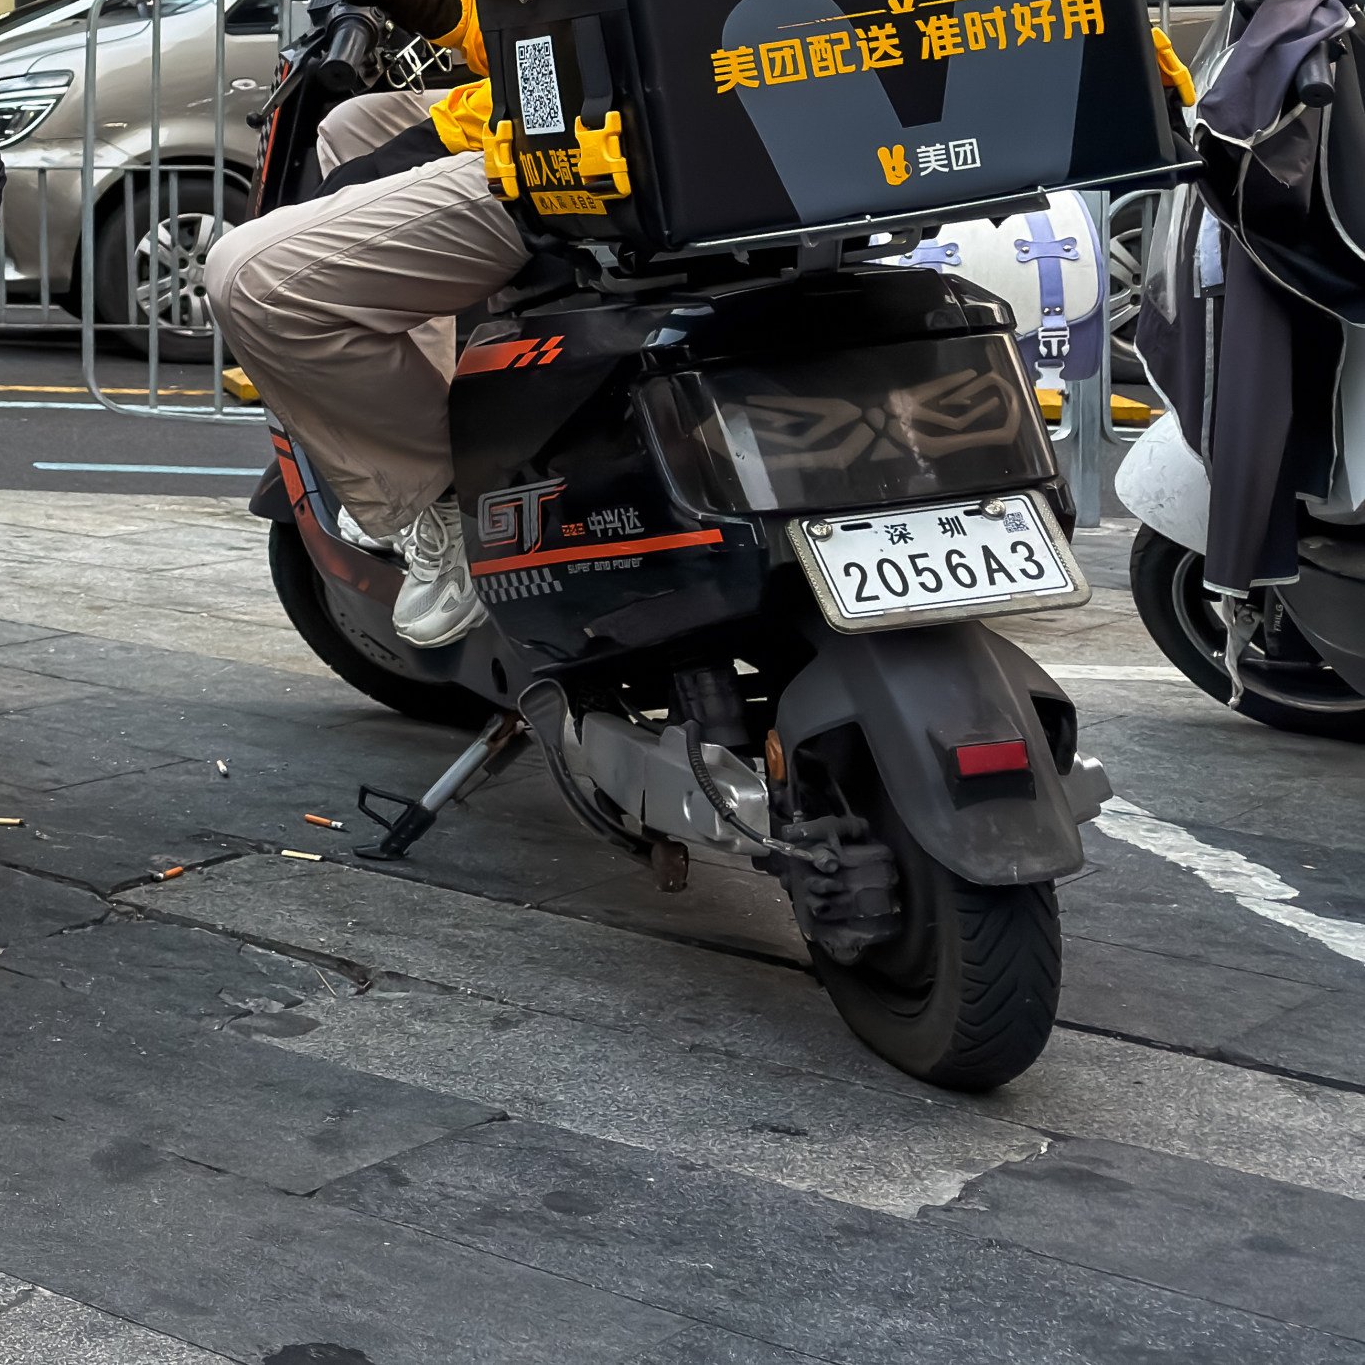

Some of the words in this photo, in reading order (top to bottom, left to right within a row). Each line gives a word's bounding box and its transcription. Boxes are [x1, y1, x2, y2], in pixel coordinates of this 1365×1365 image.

[710, 22, 904, 94] 美团配送
[916, 137, 982, 177] 美团
[477, 476, 568, 554] GT
[587, 506, 645, 539] 中兴达
[884, 515, 967, 546] 深圳
[843, 540, 1045, 604] 2056A3
